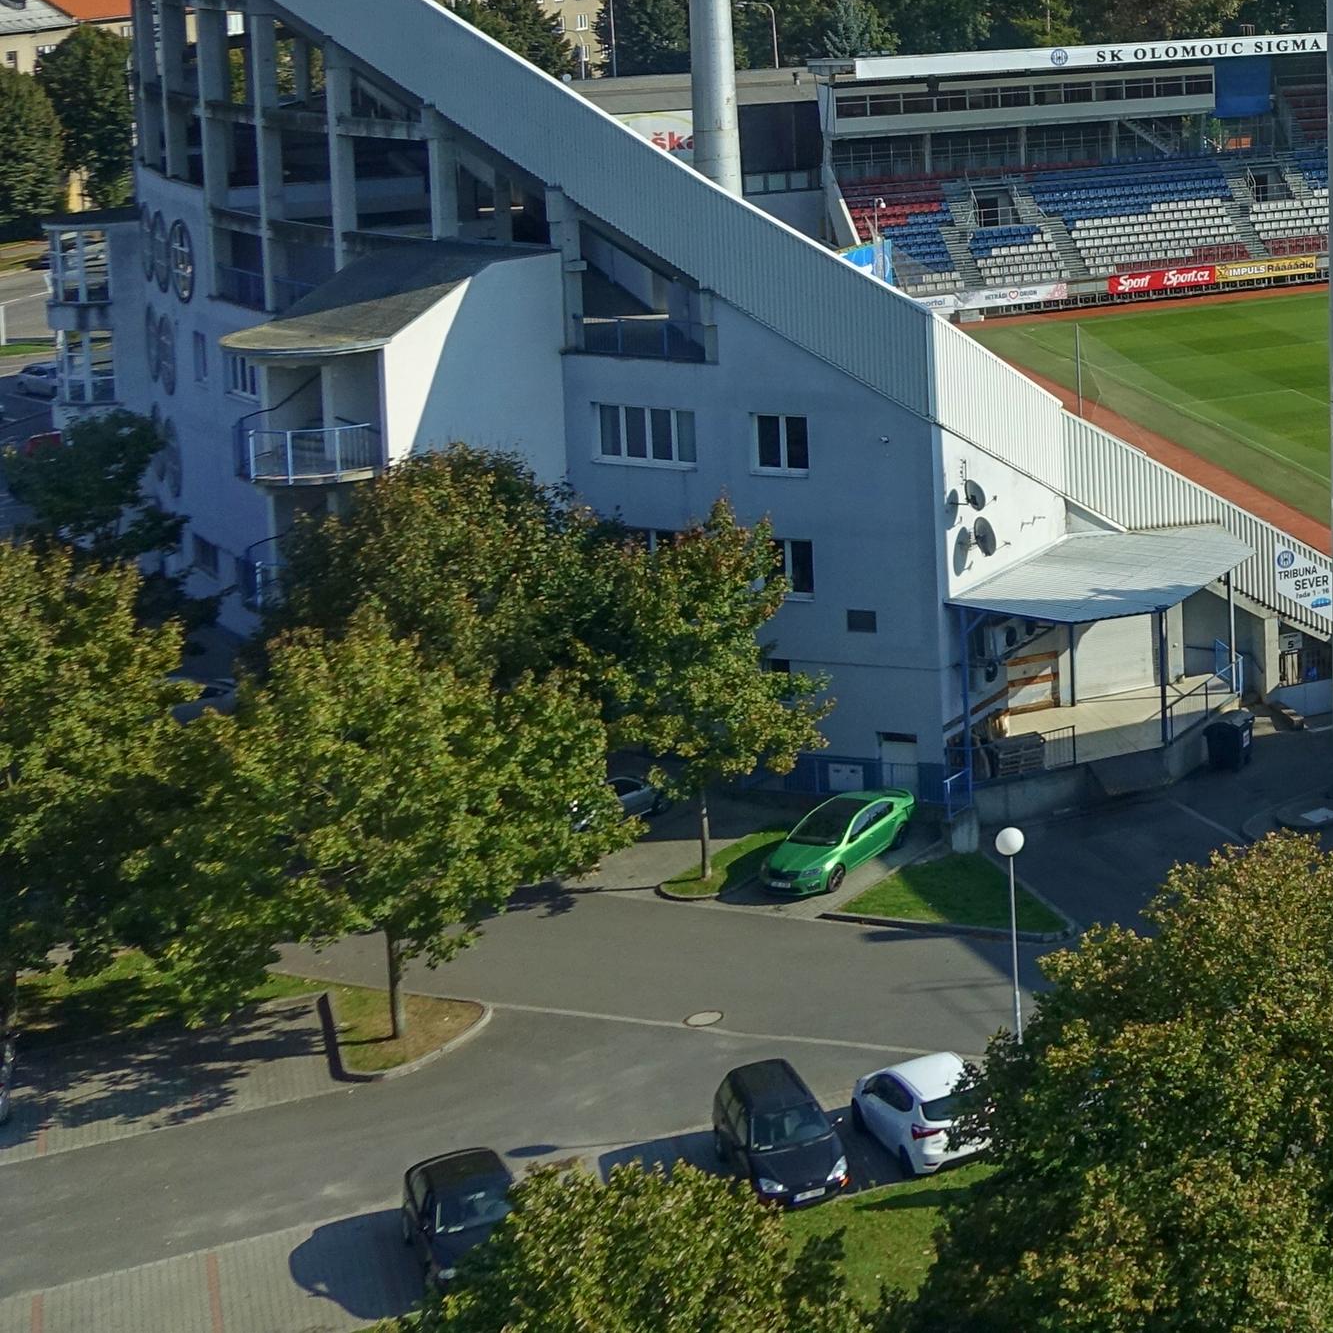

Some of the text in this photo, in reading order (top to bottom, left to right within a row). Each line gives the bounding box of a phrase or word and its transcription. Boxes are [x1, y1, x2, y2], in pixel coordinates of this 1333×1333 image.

[1096, 37, 1322, 63] SK OLOMOUC SIGMA
[1163, 269, 1210, 286] iSport.cz
[1229, 265, 1265, 276] IMPULS
[1118, 274, 1151, 291] Sport
[1278, 565, 1317, 581] TRIBUNA
[1294, 575, 1329, 591] SEVER
[1288, 640, 1294, 648] 5
